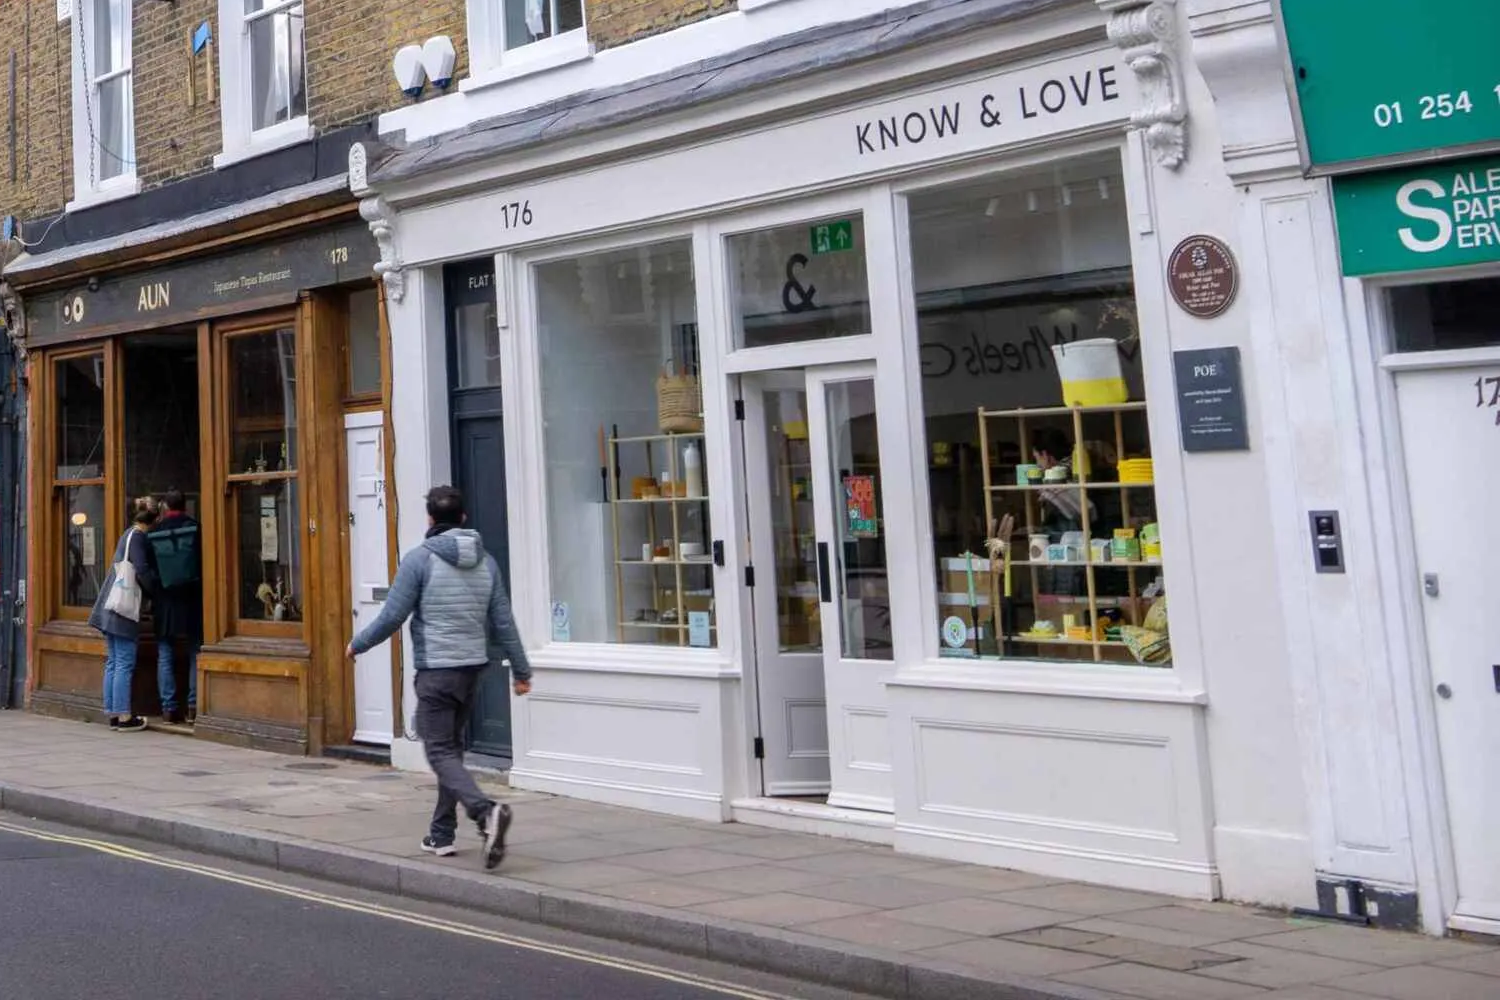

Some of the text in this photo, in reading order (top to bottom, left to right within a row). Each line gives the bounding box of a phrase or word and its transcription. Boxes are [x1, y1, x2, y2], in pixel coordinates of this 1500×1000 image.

[855, 64, 1120, 155] KNOW & LOVE
[1373, 101, 1403, 128] 01
[1419, 90, 1473, 120] 254
[500, 200, 533, 230] 176
[330, 246, 348, 265] 178
[137, 281, 170, 313] AUN
[213, 268, 292, 296] Japanese Tapas Restaurant
[468, 274, 490, 289] FLAT
[781, 252, 818, 313] &
[1193, 364, 1217, 377] POE
[1474, 375, 1500, 407] 17
